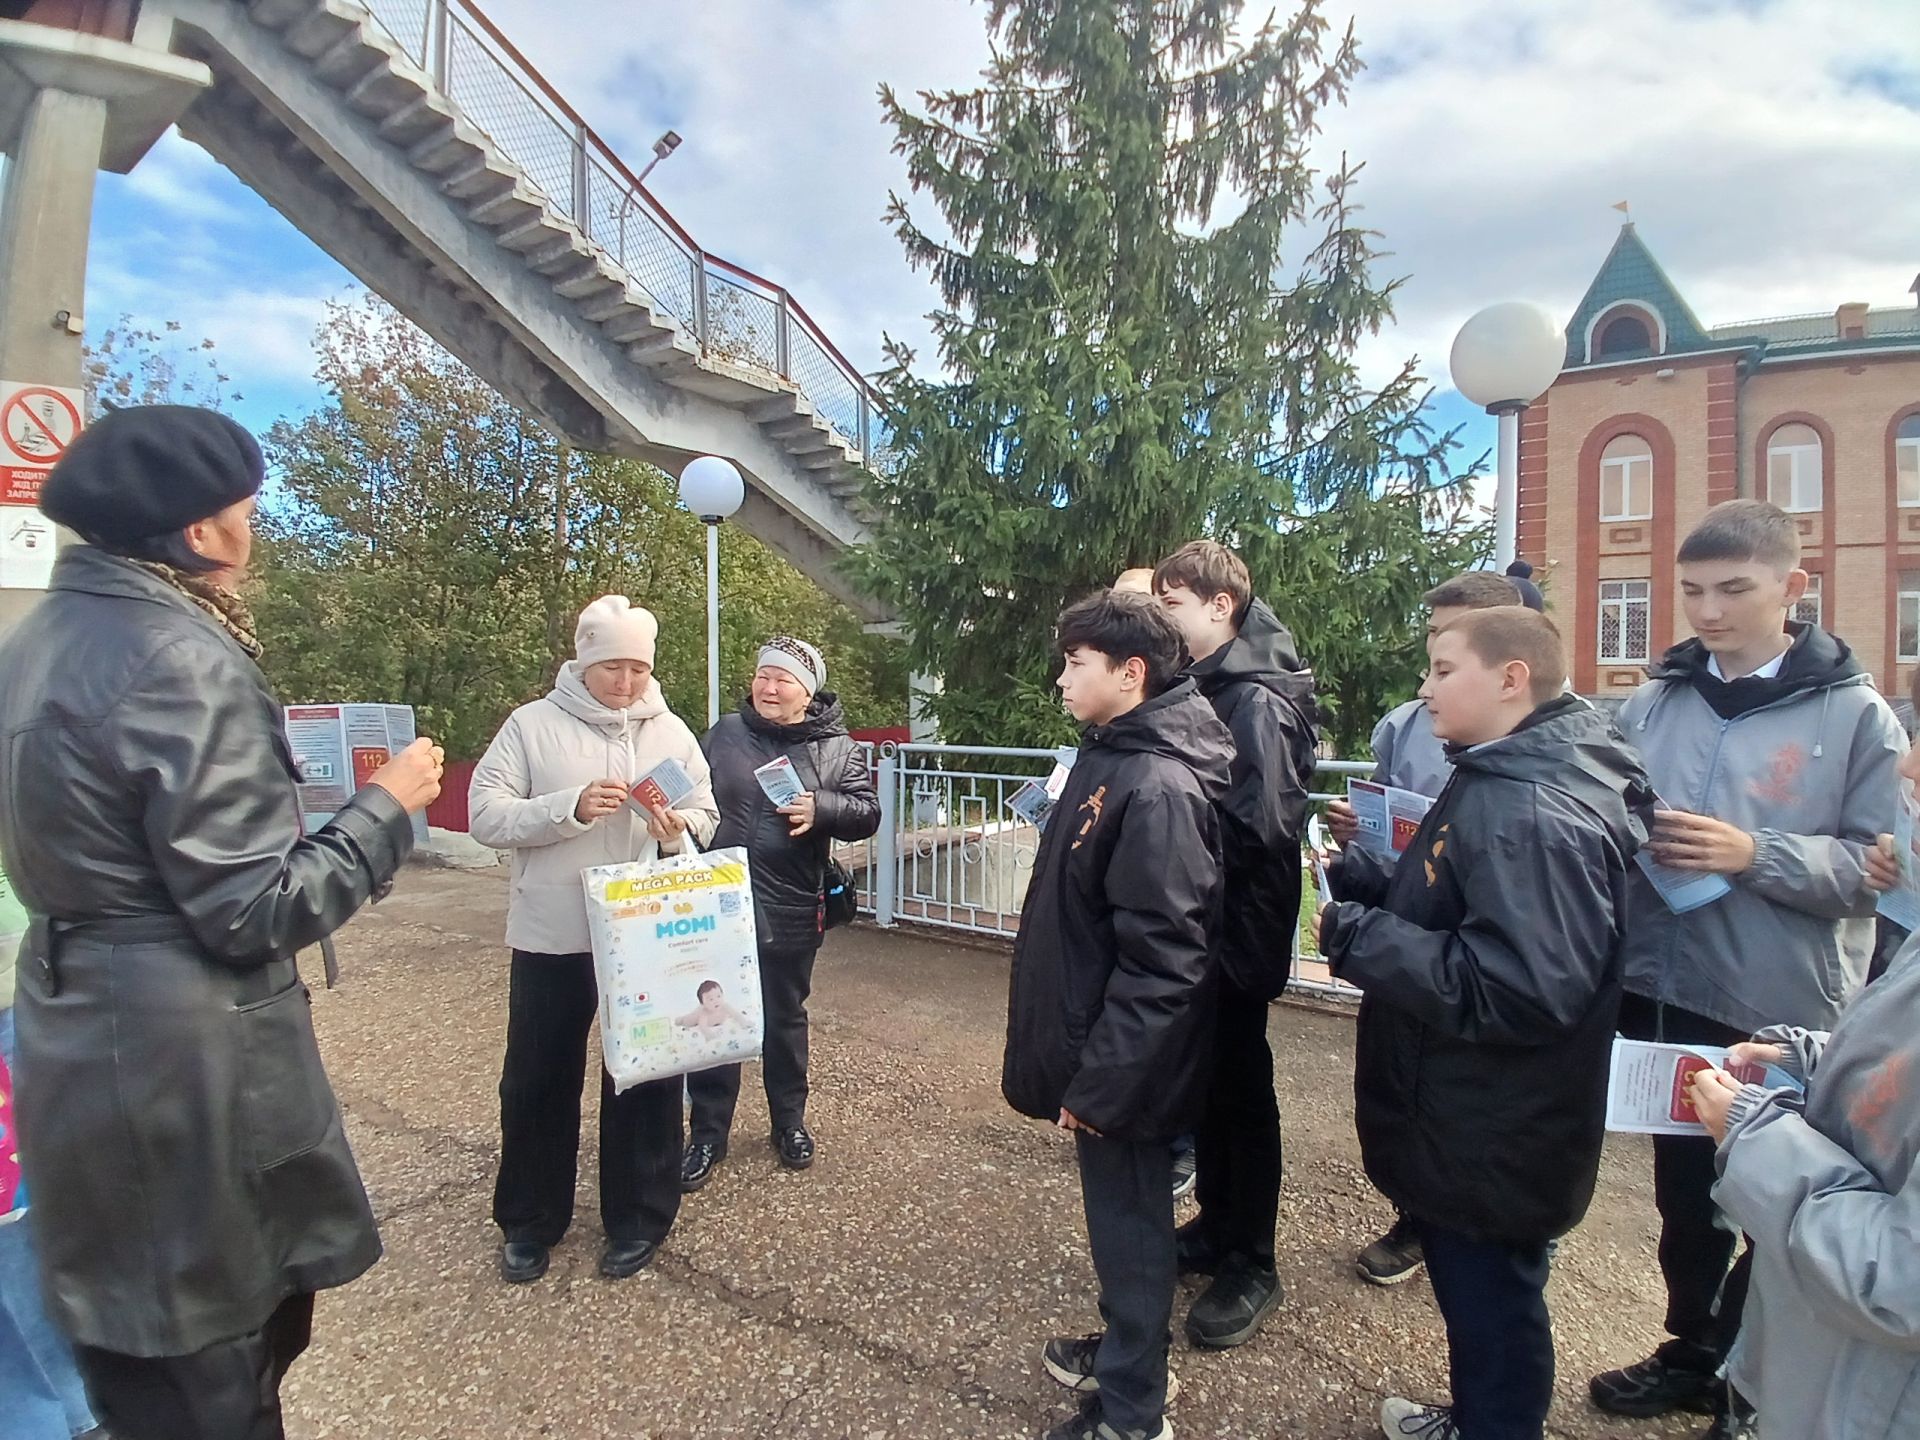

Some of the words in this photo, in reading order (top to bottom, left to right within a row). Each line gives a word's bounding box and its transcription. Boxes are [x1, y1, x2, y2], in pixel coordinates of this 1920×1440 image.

[6, 489, 40, 499] ЗАПРЕ
[362, 753, 384, 768] 112
[645, 785, 661, 803] 112
[1399, 823, 1417, 836] 112
[631, 877, 672, 892] MEGA
[676, 871, 713, 885] PACK
